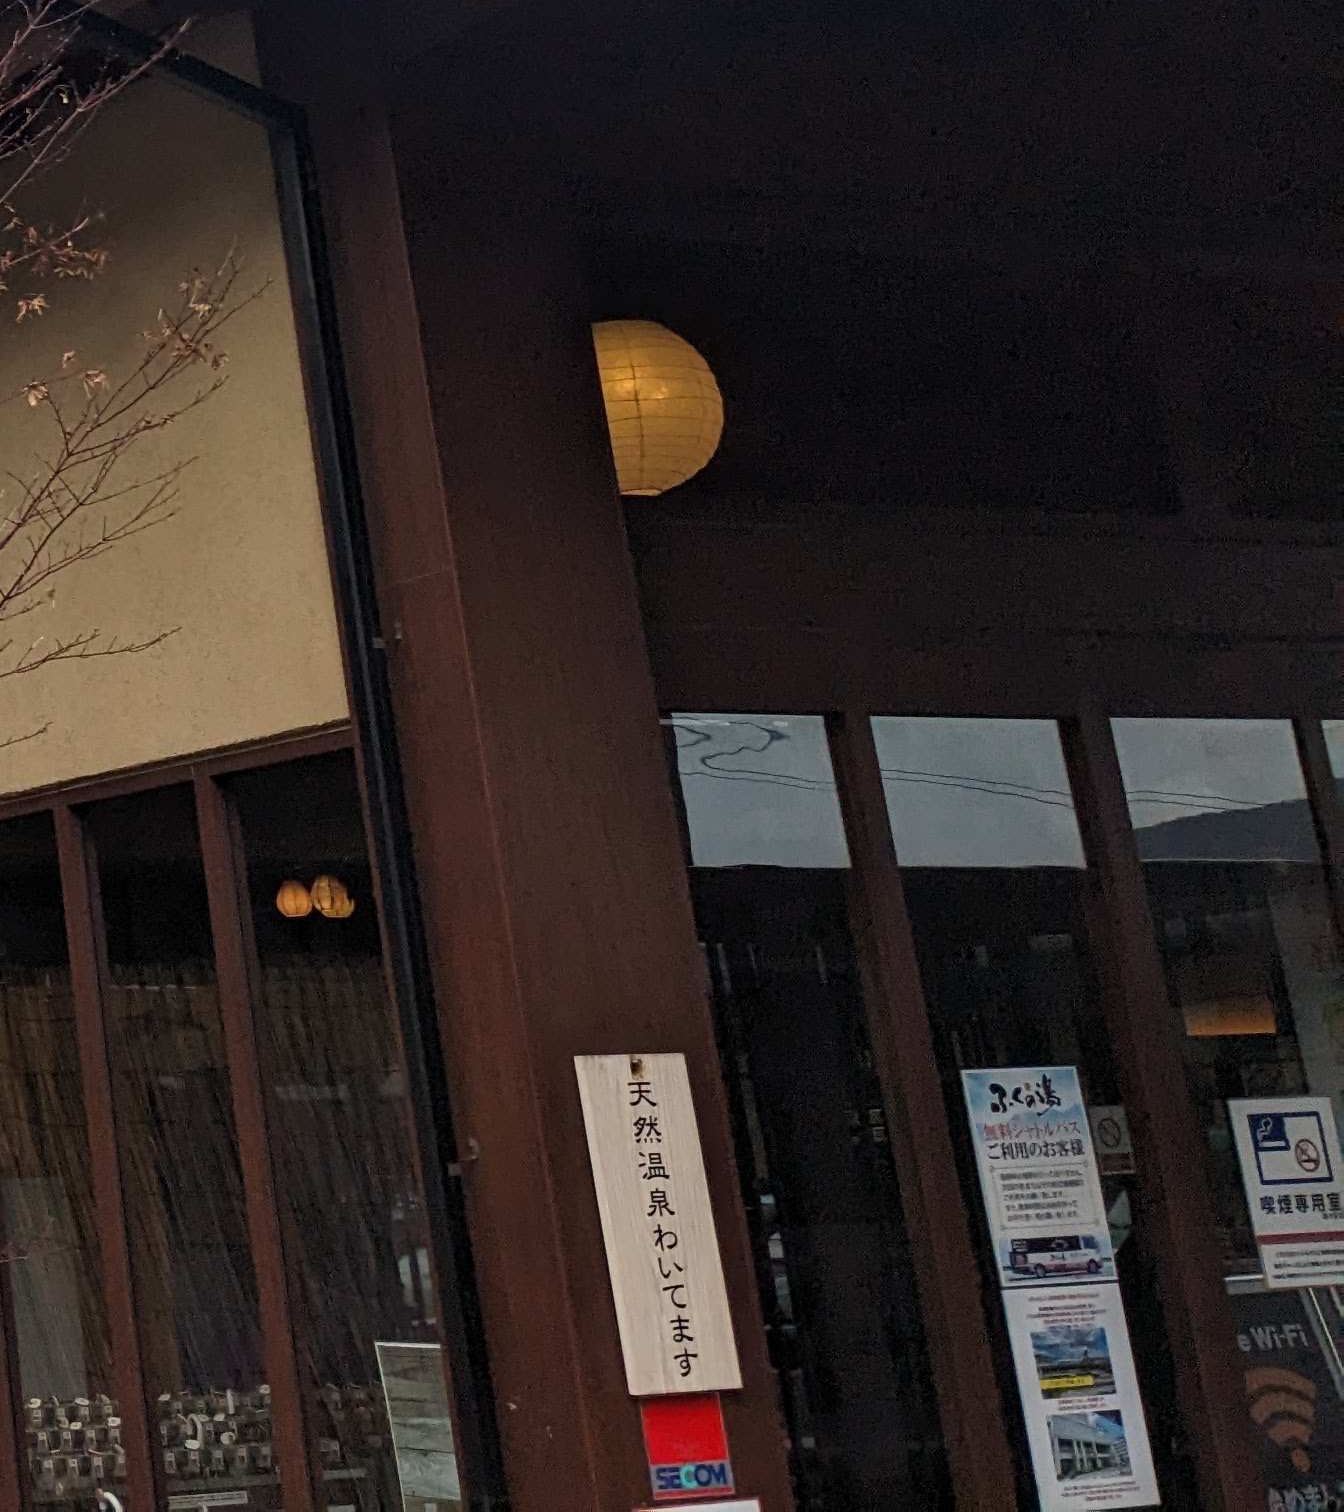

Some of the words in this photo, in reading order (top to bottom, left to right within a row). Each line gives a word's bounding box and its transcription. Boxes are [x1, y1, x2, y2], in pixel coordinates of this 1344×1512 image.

[989, 1073, 1062, 1116] ふくの湯
[987, 1138, 1085, 1160] ご利用のお客様
[1259, 1192, 1342, 1216] 喫煙専用室
[627, 1081, 699, 1378] 天然温泉わいてます
[656, 1463, 728, 1489] SECOM
